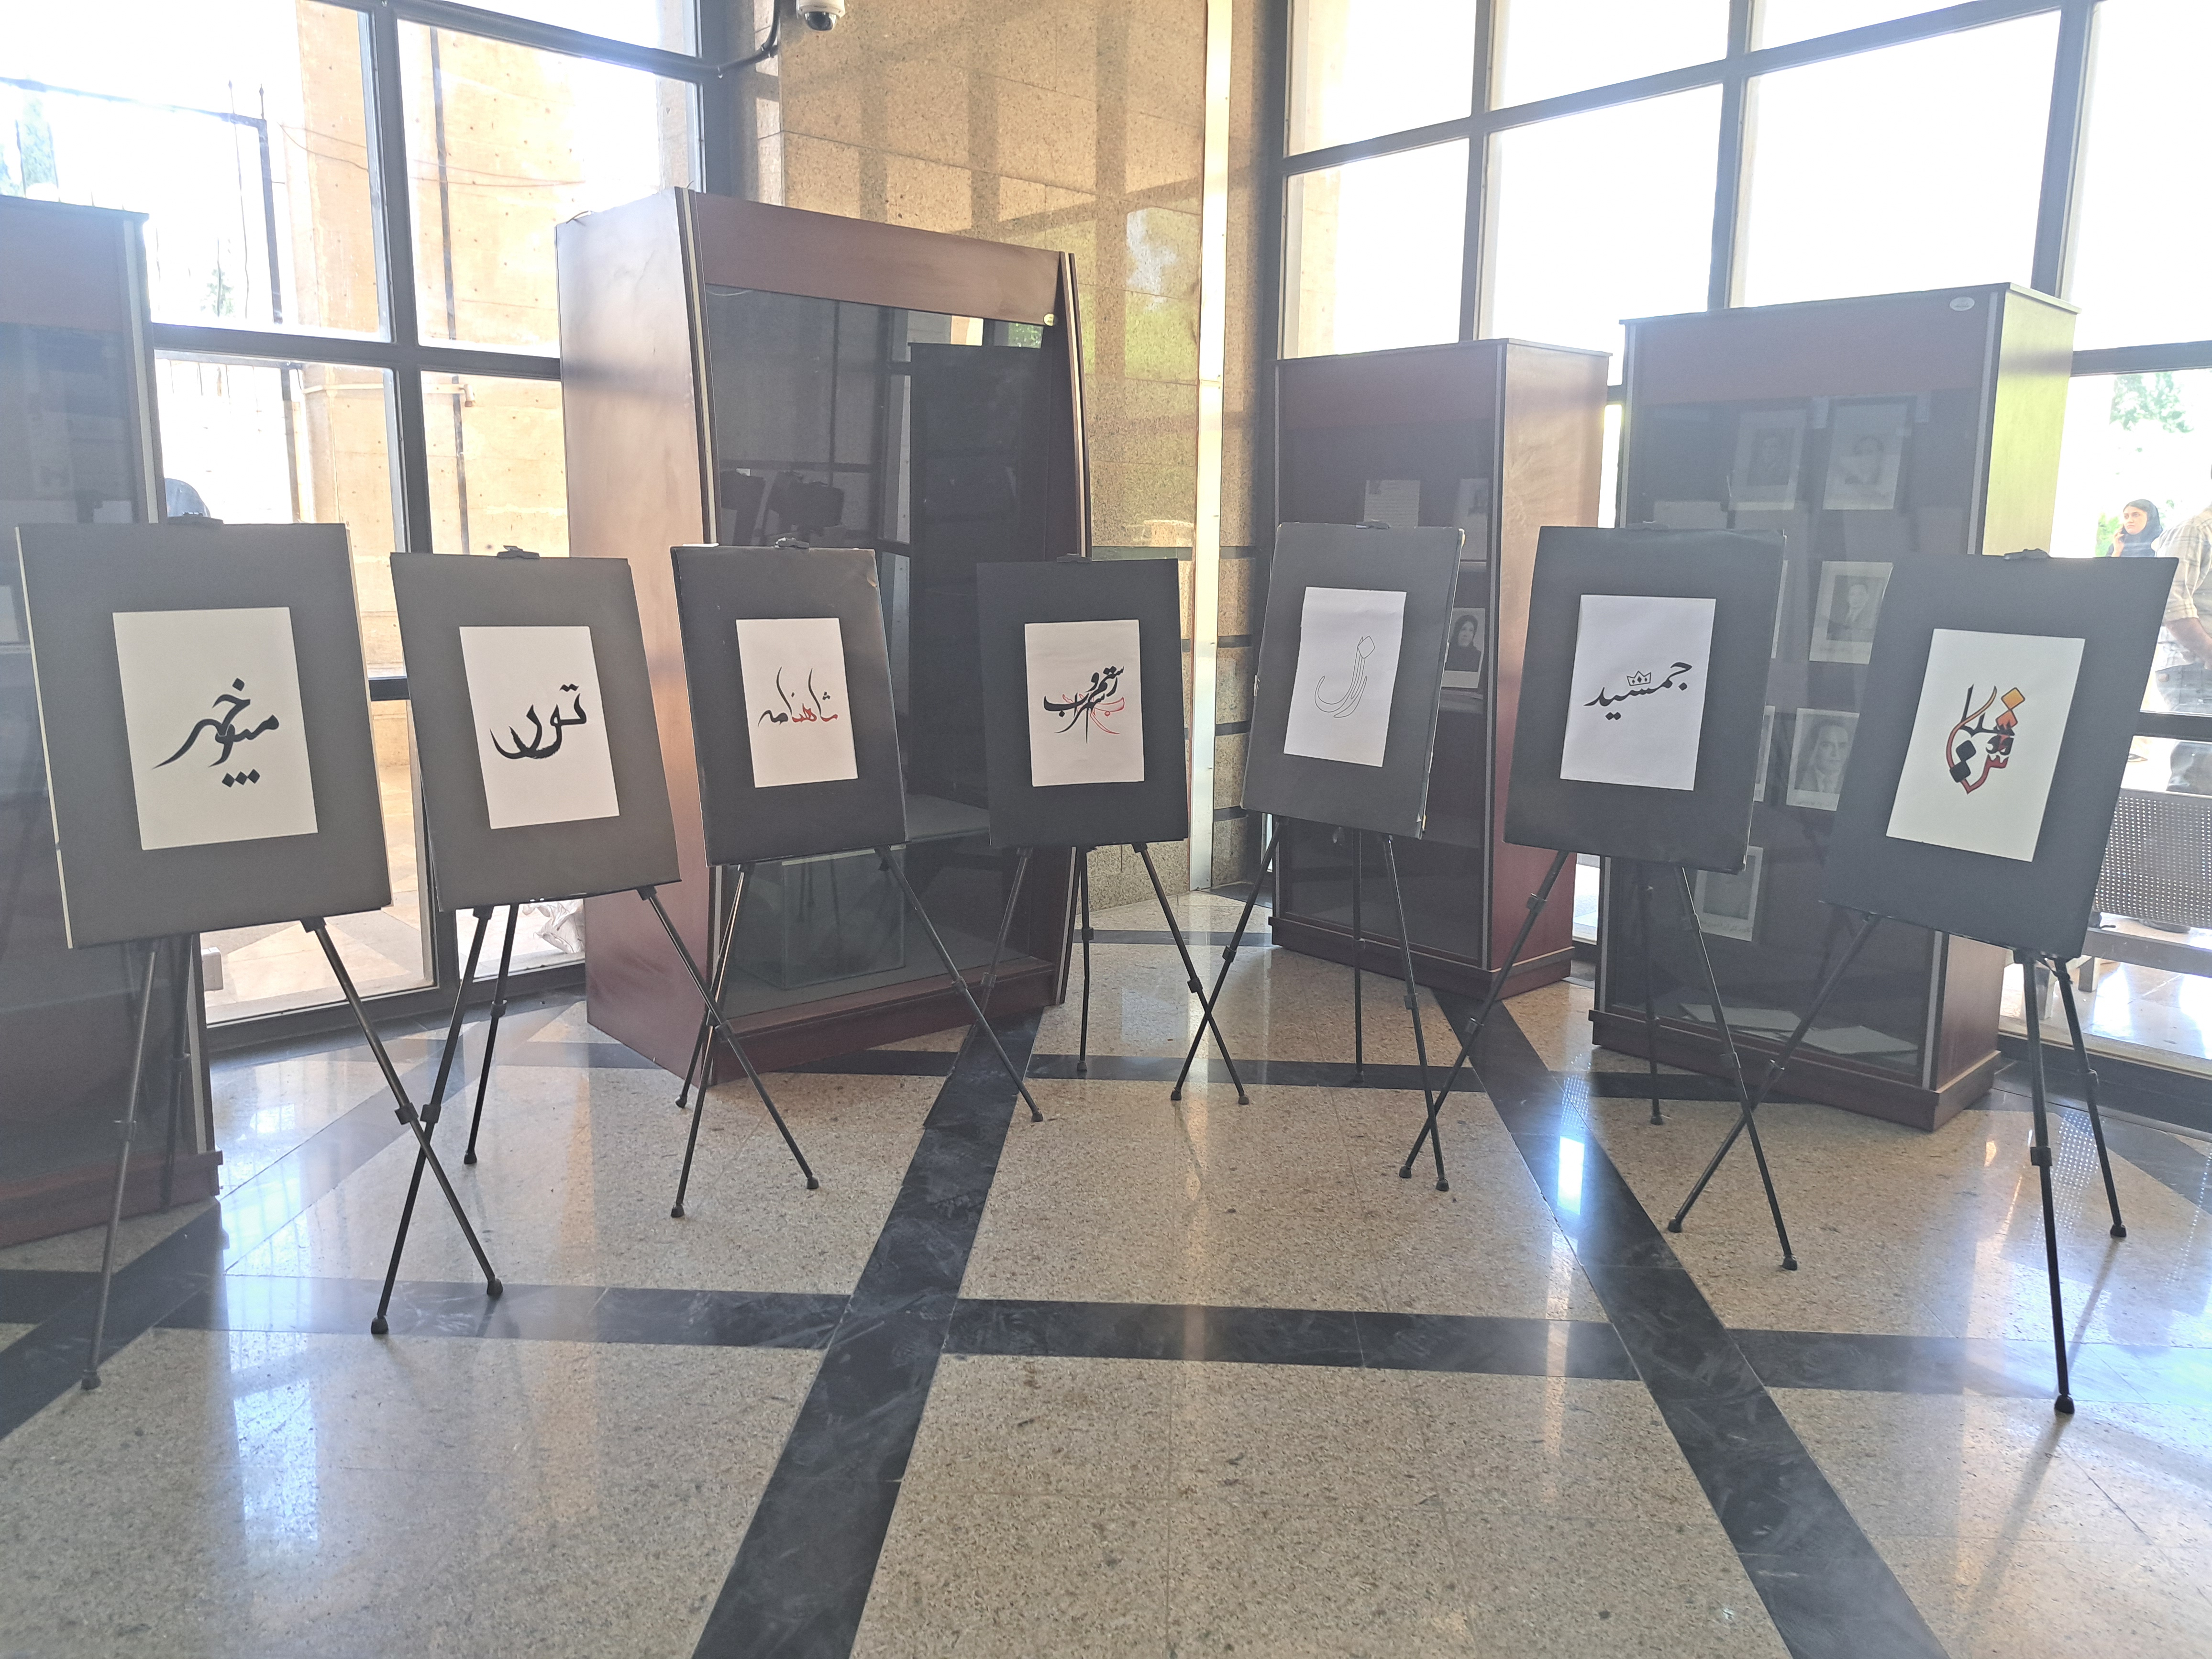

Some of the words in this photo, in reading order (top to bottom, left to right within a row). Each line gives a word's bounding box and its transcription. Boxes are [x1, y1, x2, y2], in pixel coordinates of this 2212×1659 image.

[758, 666, 838, 727] شاهنامه
[1084, 672, 1099, 693] و
[1583, 662, 1692, 720] جمشید
[1044, 693, 1105, 734] سهراب
